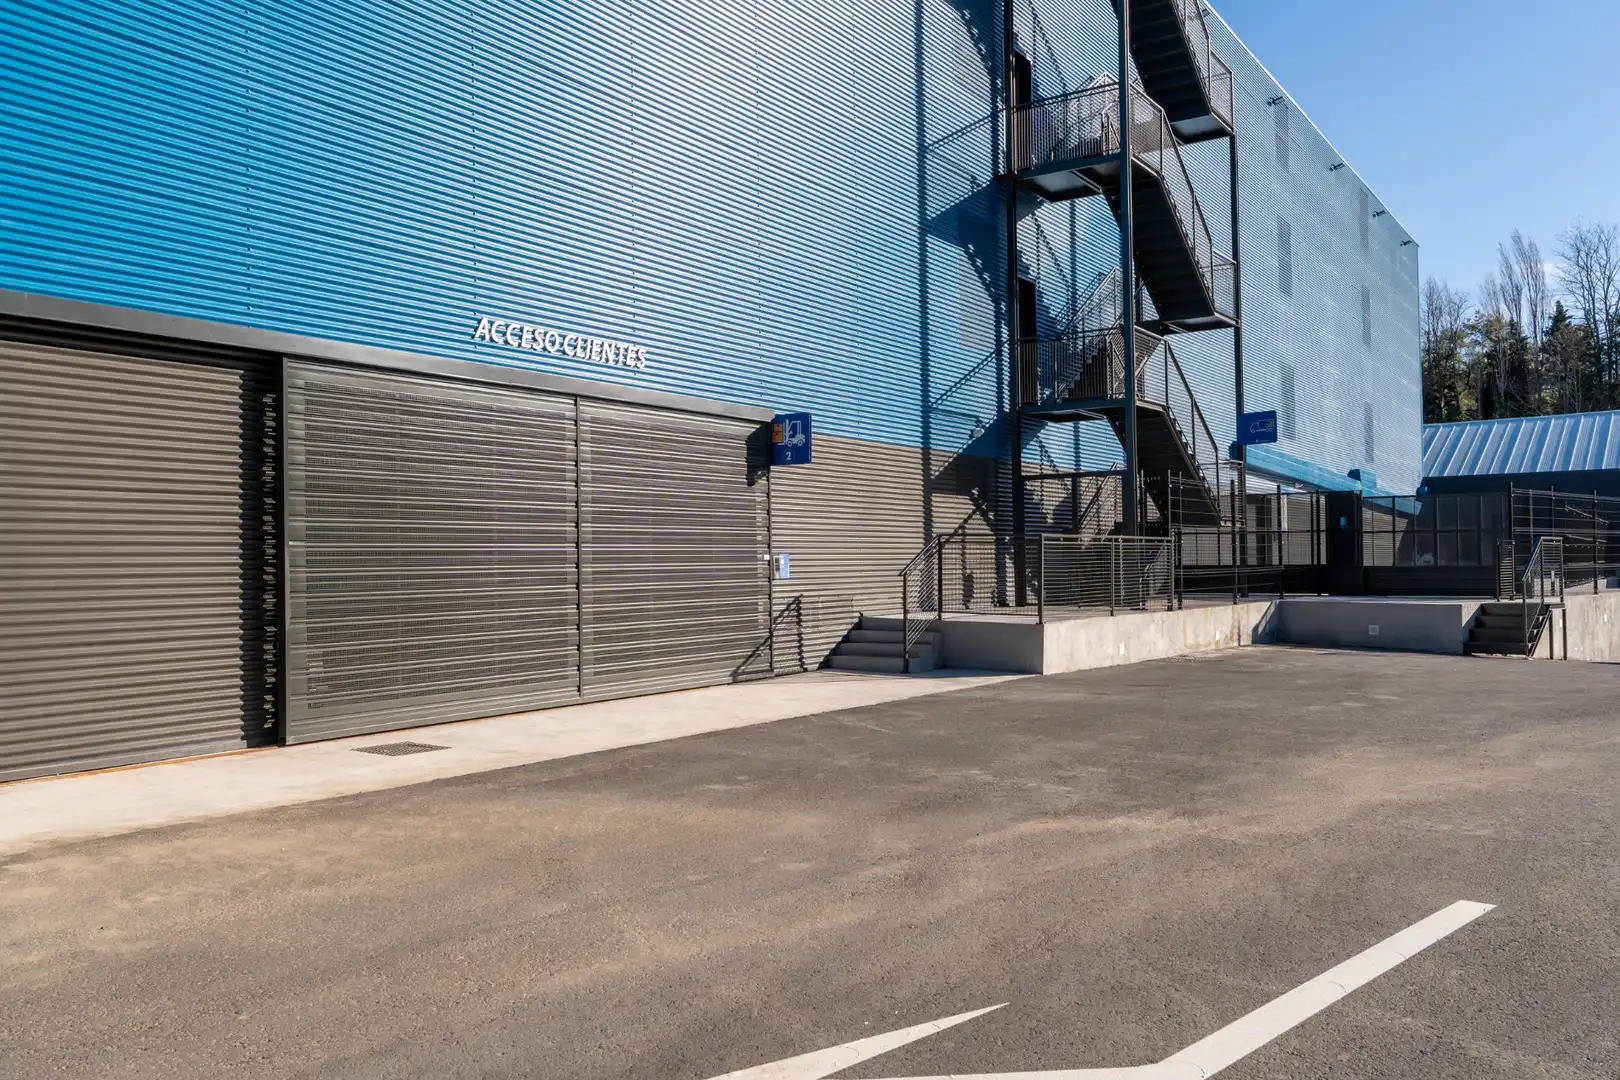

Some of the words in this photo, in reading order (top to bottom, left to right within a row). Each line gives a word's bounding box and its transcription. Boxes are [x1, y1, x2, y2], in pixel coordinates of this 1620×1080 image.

[474, 317, 560, 353] ACCESO
[563, 335, 647, 369] CLIENTES
[785, 451, 792, 461] 2
